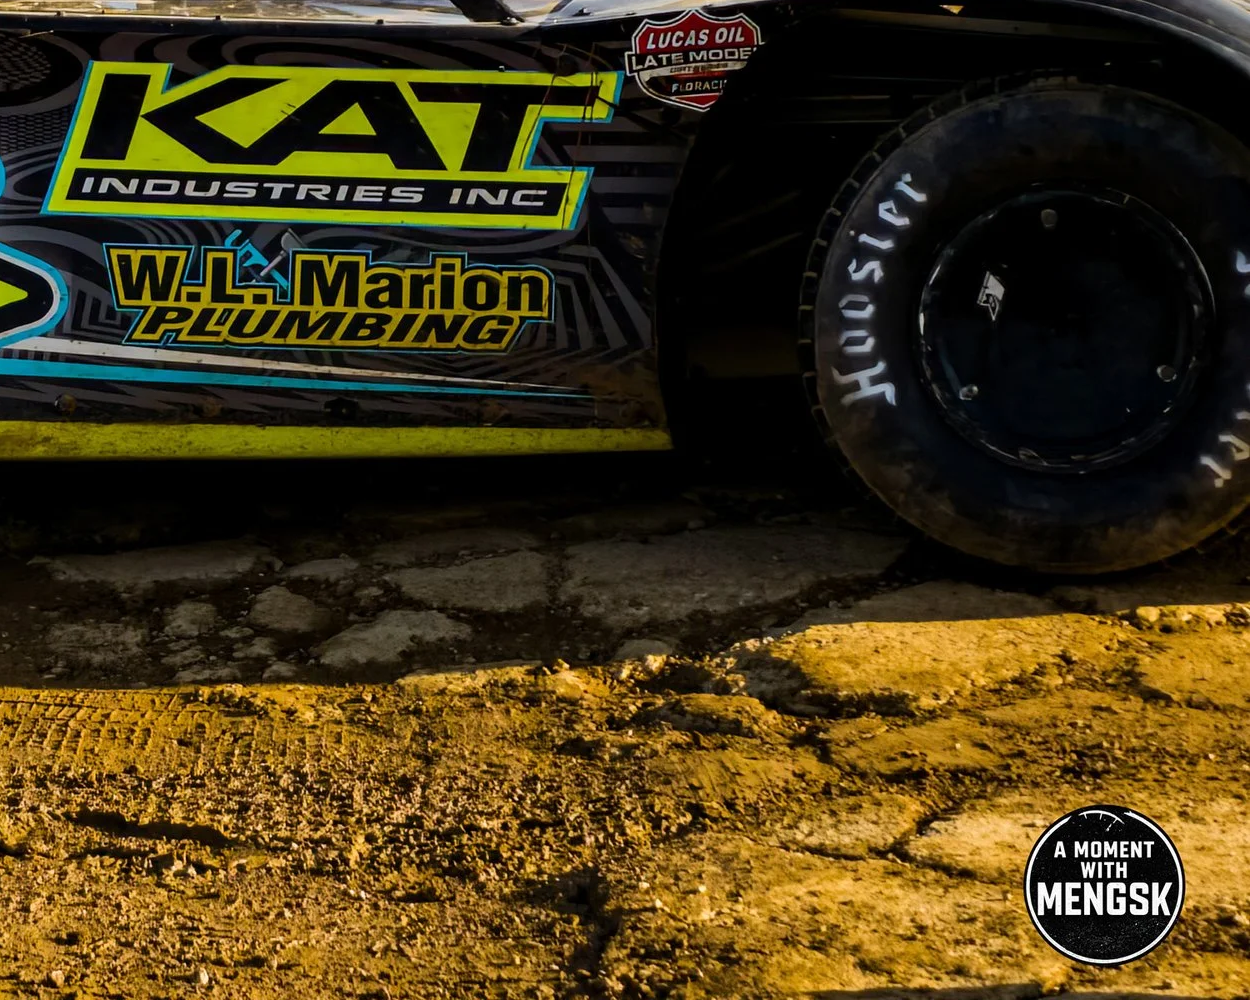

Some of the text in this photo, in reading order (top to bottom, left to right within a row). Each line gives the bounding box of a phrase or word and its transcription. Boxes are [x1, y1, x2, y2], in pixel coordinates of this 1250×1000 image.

[647, 27, 745, 50] LUCAS OIL
[632, 52, 684, 70] LATE
[689, 47, 757, 62] MODE
[672, 80, 727, 93] FLORACI
[80, 73, 602, 172] KAT
[82, 176, 549, 207] INDUSTRIES INC
[118, 250, 543, 314] W.L. Marion
[831, 173, 928, 406] Hoosier
[151, 306, 520, 347] PLUMBING
